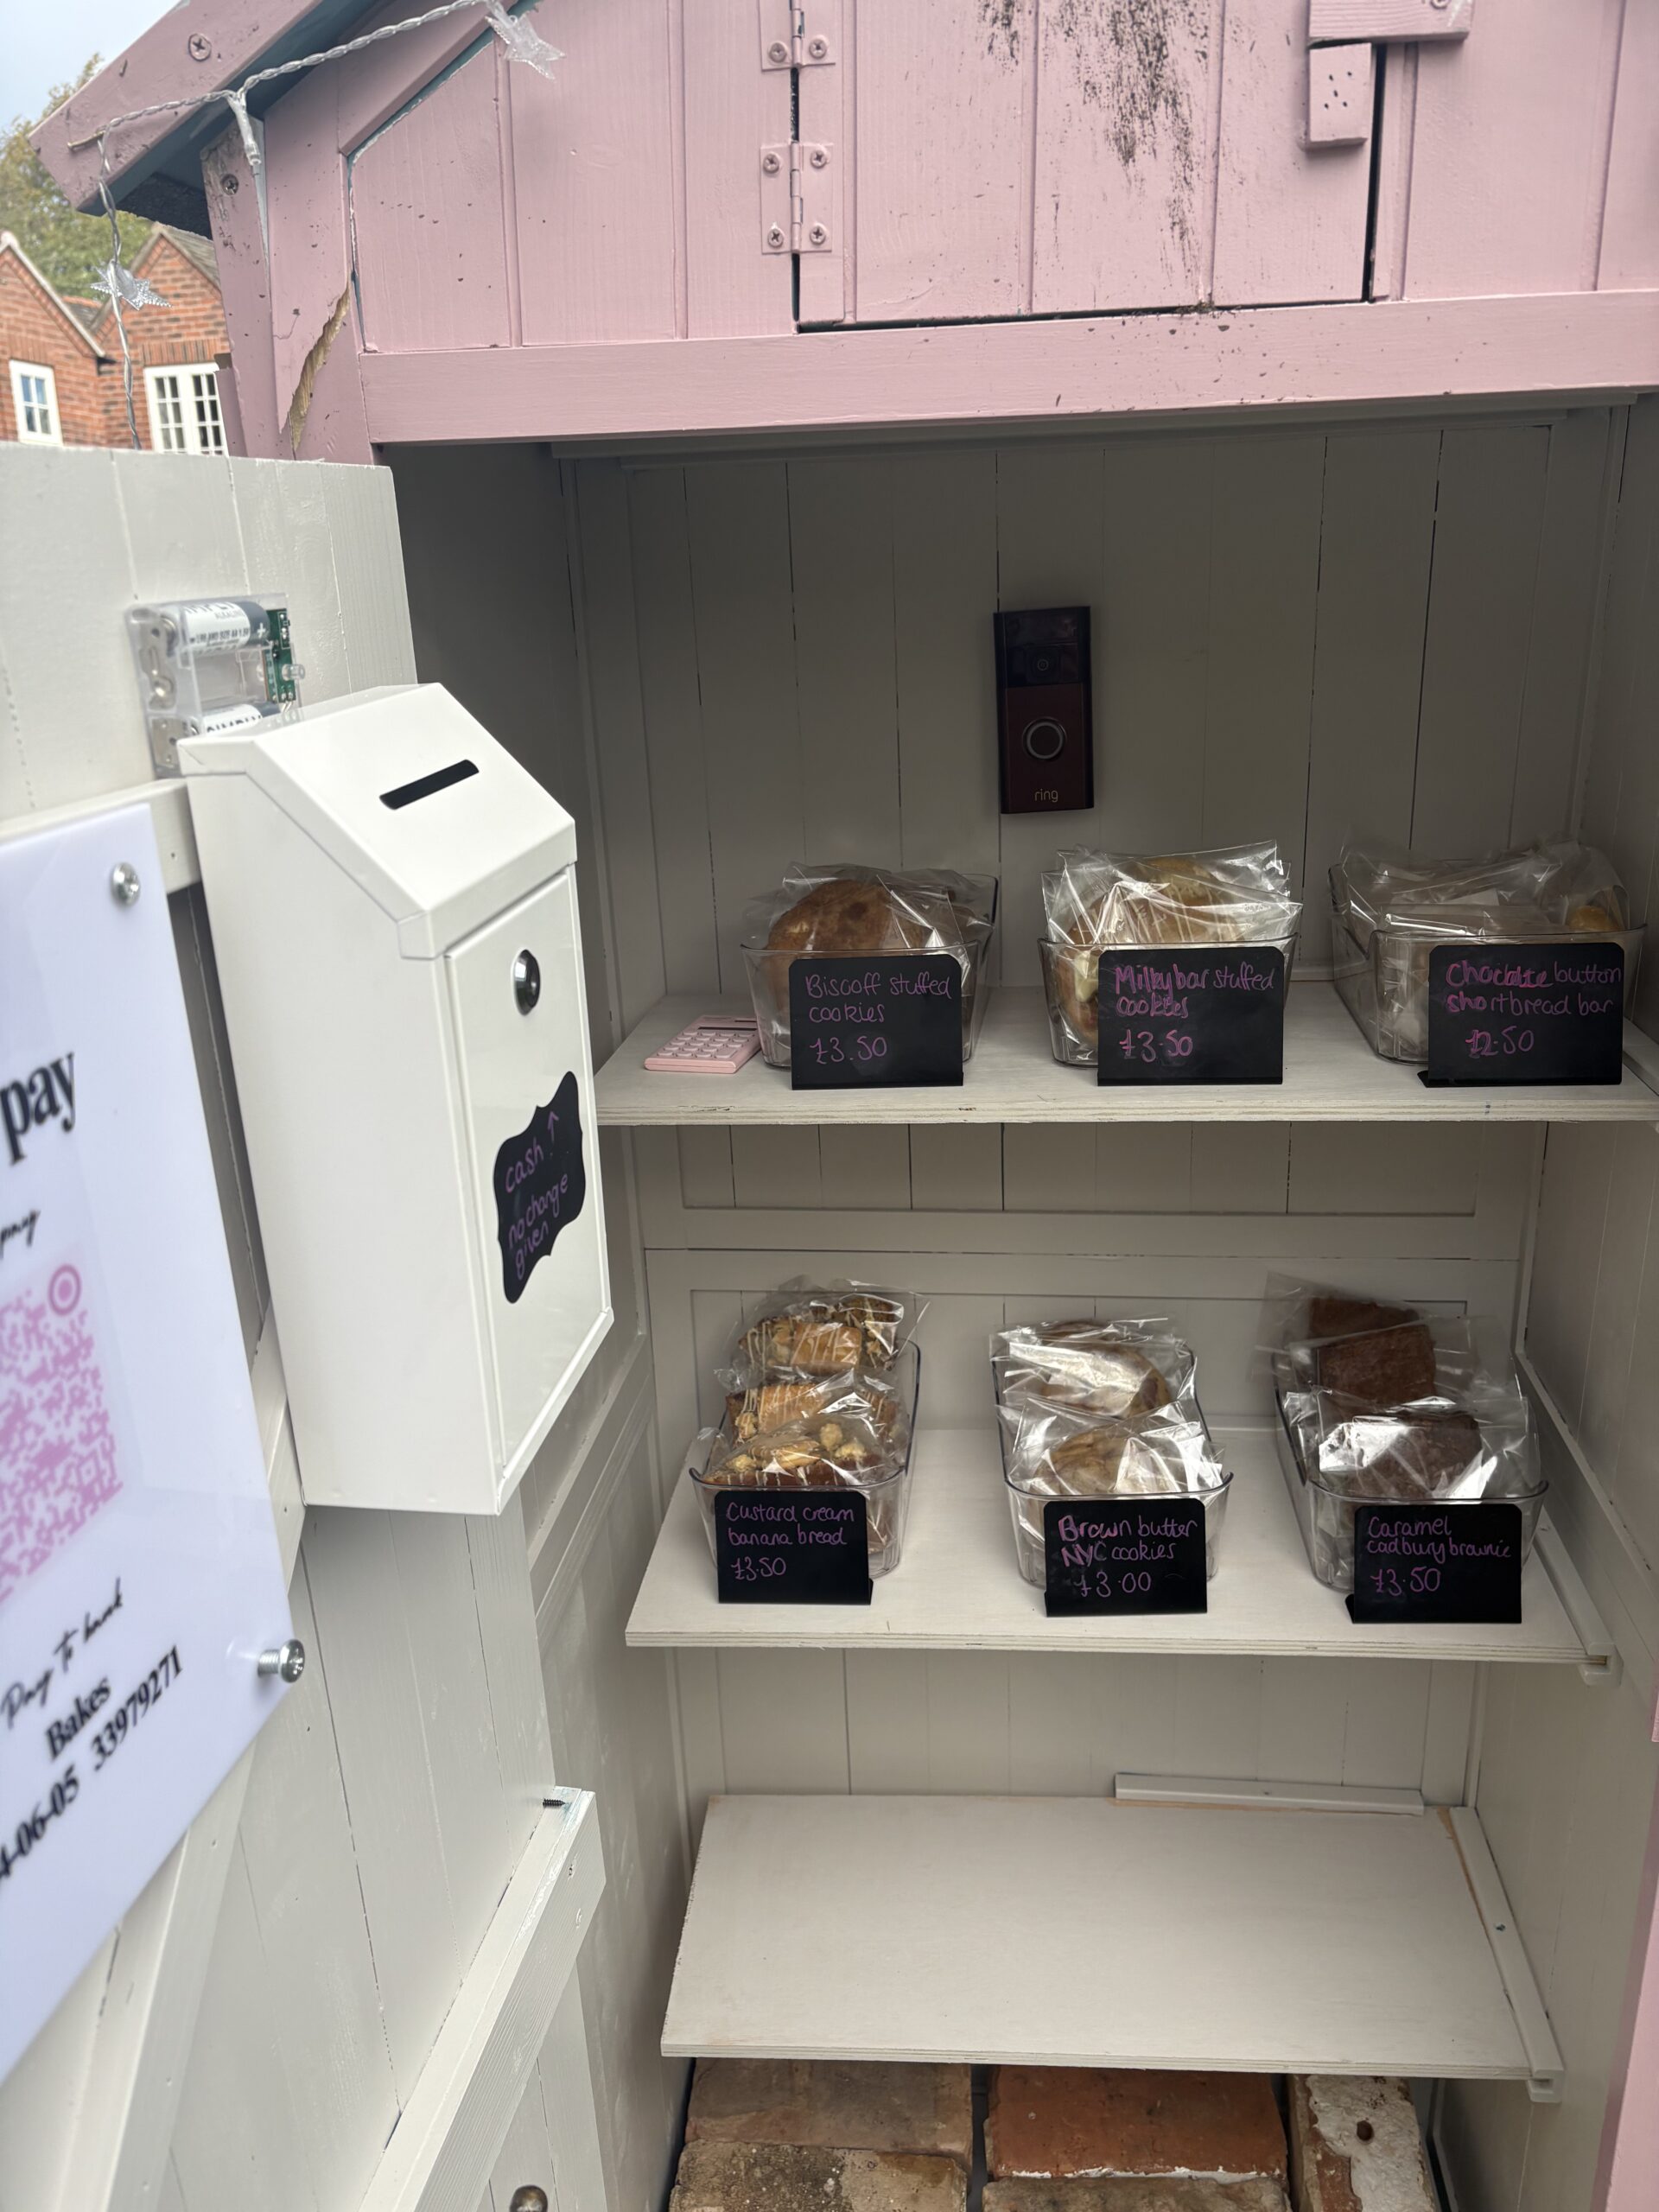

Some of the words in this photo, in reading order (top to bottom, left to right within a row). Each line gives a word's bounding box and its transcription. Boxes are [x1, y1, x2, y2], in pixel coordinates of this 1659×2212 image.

[1034, 788, 1058, 803] ring
[805, 972, 880, 998] Biscoff
[889, 971, 951, 999] stuffed
[1115, 963, 1210, 1002] Milkybar
[1213, 961, 1274, 991] stuffed
[1554, 962, 1622, 984] button
[809, 1002, 885, 1023] cookies
[1578, 993, 1614, 1016] bar
[810, 1035, 887, 1065] £3.50
[0, 1052, 75, 1166] pay
[505, 1136, 543, 1193] cash
[515, 1221, 549, 1281] given
[726, 1502, 798, 1522] Custard
[802, 1507, 855, 1522] cream
[728, 1527, 792, 1546] banana
[798, 1523, 848, 1545] bread
[1058, 1515, 1132, 1541] Brown
[1138, 1515, 1198, 1538] butter
[1368, 1516, 1452, 1538] Caramel
[1061, 1541, 1107, 1567] NYC
[1111, 1540, 1176, 1561] cookies
[1449, 1537, 1512, 1558] brownie
[731, 1556, 787, 1581] £3.50
[1370, 1567, 1441, 1596] £3.50
[46, 1676, 111, 1764] Bakes
[92, 1644, 183, 1771] 33979271
